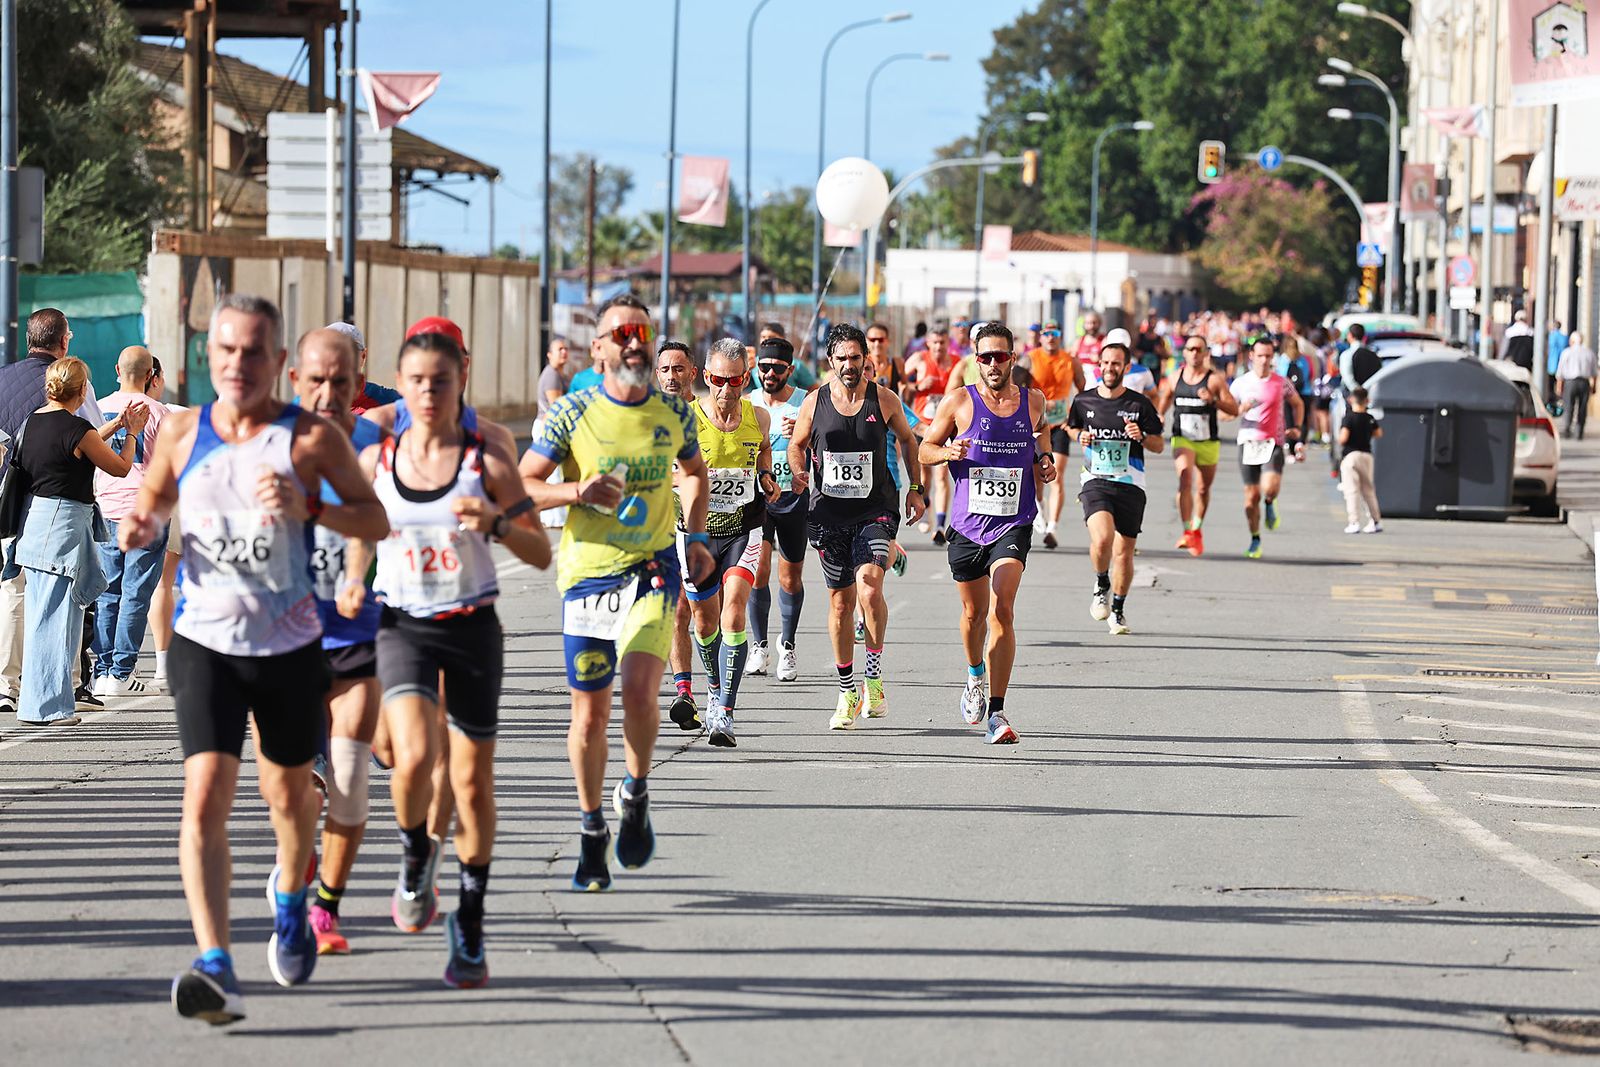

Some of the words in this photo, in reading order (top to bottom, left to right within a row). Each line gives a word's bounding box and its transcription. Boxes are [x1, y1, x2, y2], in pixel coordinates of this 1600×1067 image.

[972, 439, 1006, 447] WELLNESS
[1098, 449, 1122, 461] 613
[832, 465, 864, 481] 183
[710, 480, 746, 496] 225
[974, 480, 1017, 498] 1339
[212, 537, 271, 562] 226
[404, 547, 460, 574] 126
